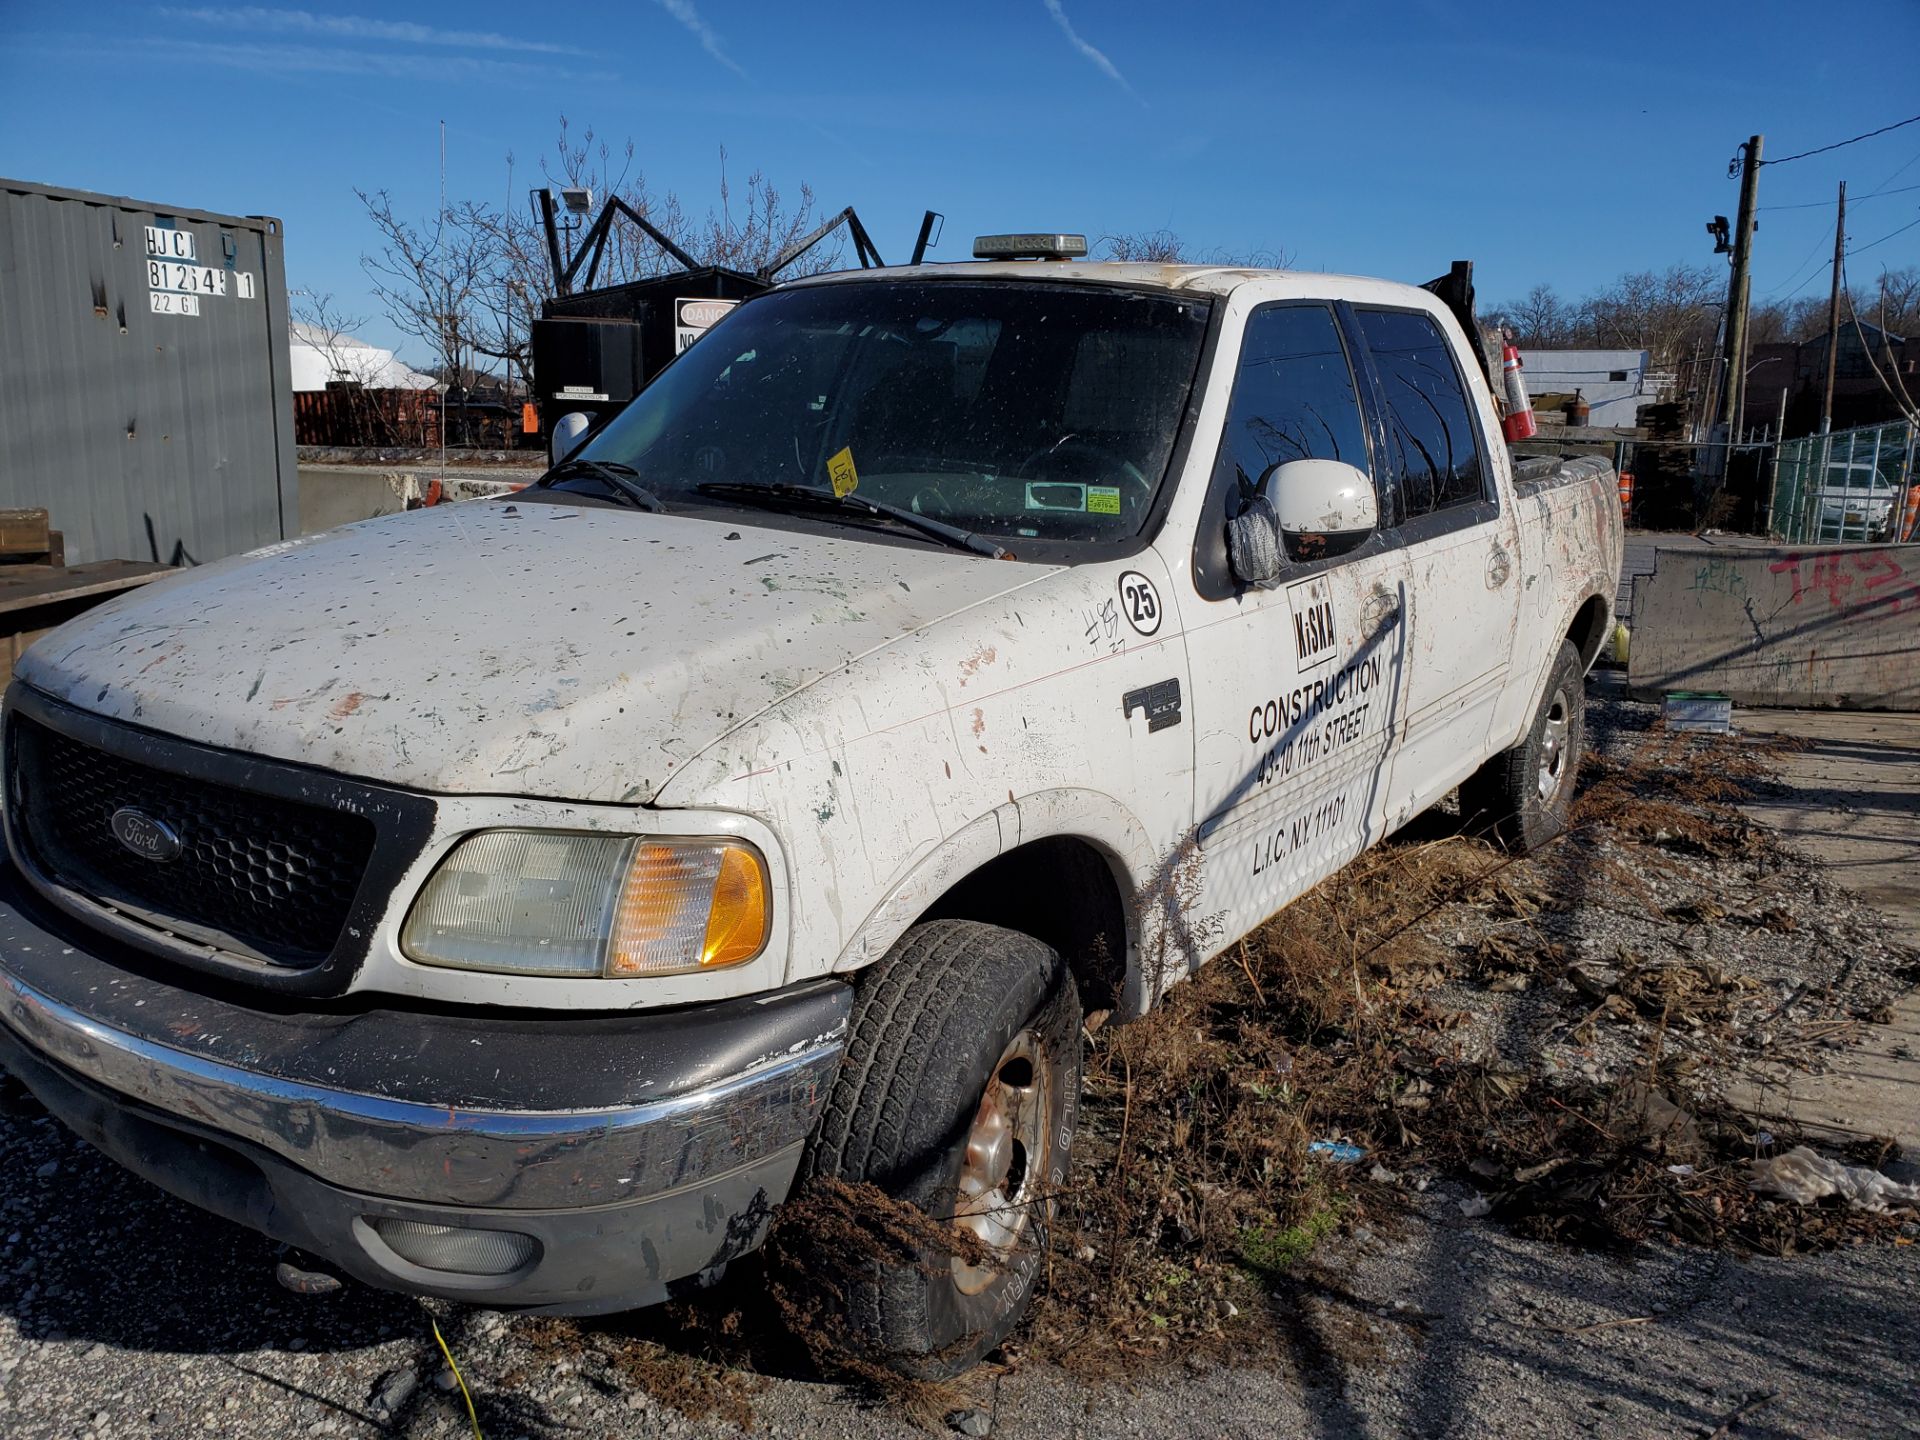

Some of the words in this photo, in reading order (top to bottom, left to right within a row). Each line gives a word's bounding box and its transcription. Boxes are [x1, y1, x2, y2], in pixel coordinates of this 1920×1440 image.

[1126, 583, 1156, 622] 25
[1152, 701, 1177, 715] XLT
[1249, 654, 1381, 744] CONSTRUCTION
[1257, 740, 1294, 788] 43-10
[1297, 727, 1320, 769] 11th
[1323, 703, 1370, 755] STREET
[125, 817, 159, 851] Ford
[1315, 792, 1347, 838] 11101
[1058, 1065, 1077, 1151] WILD
